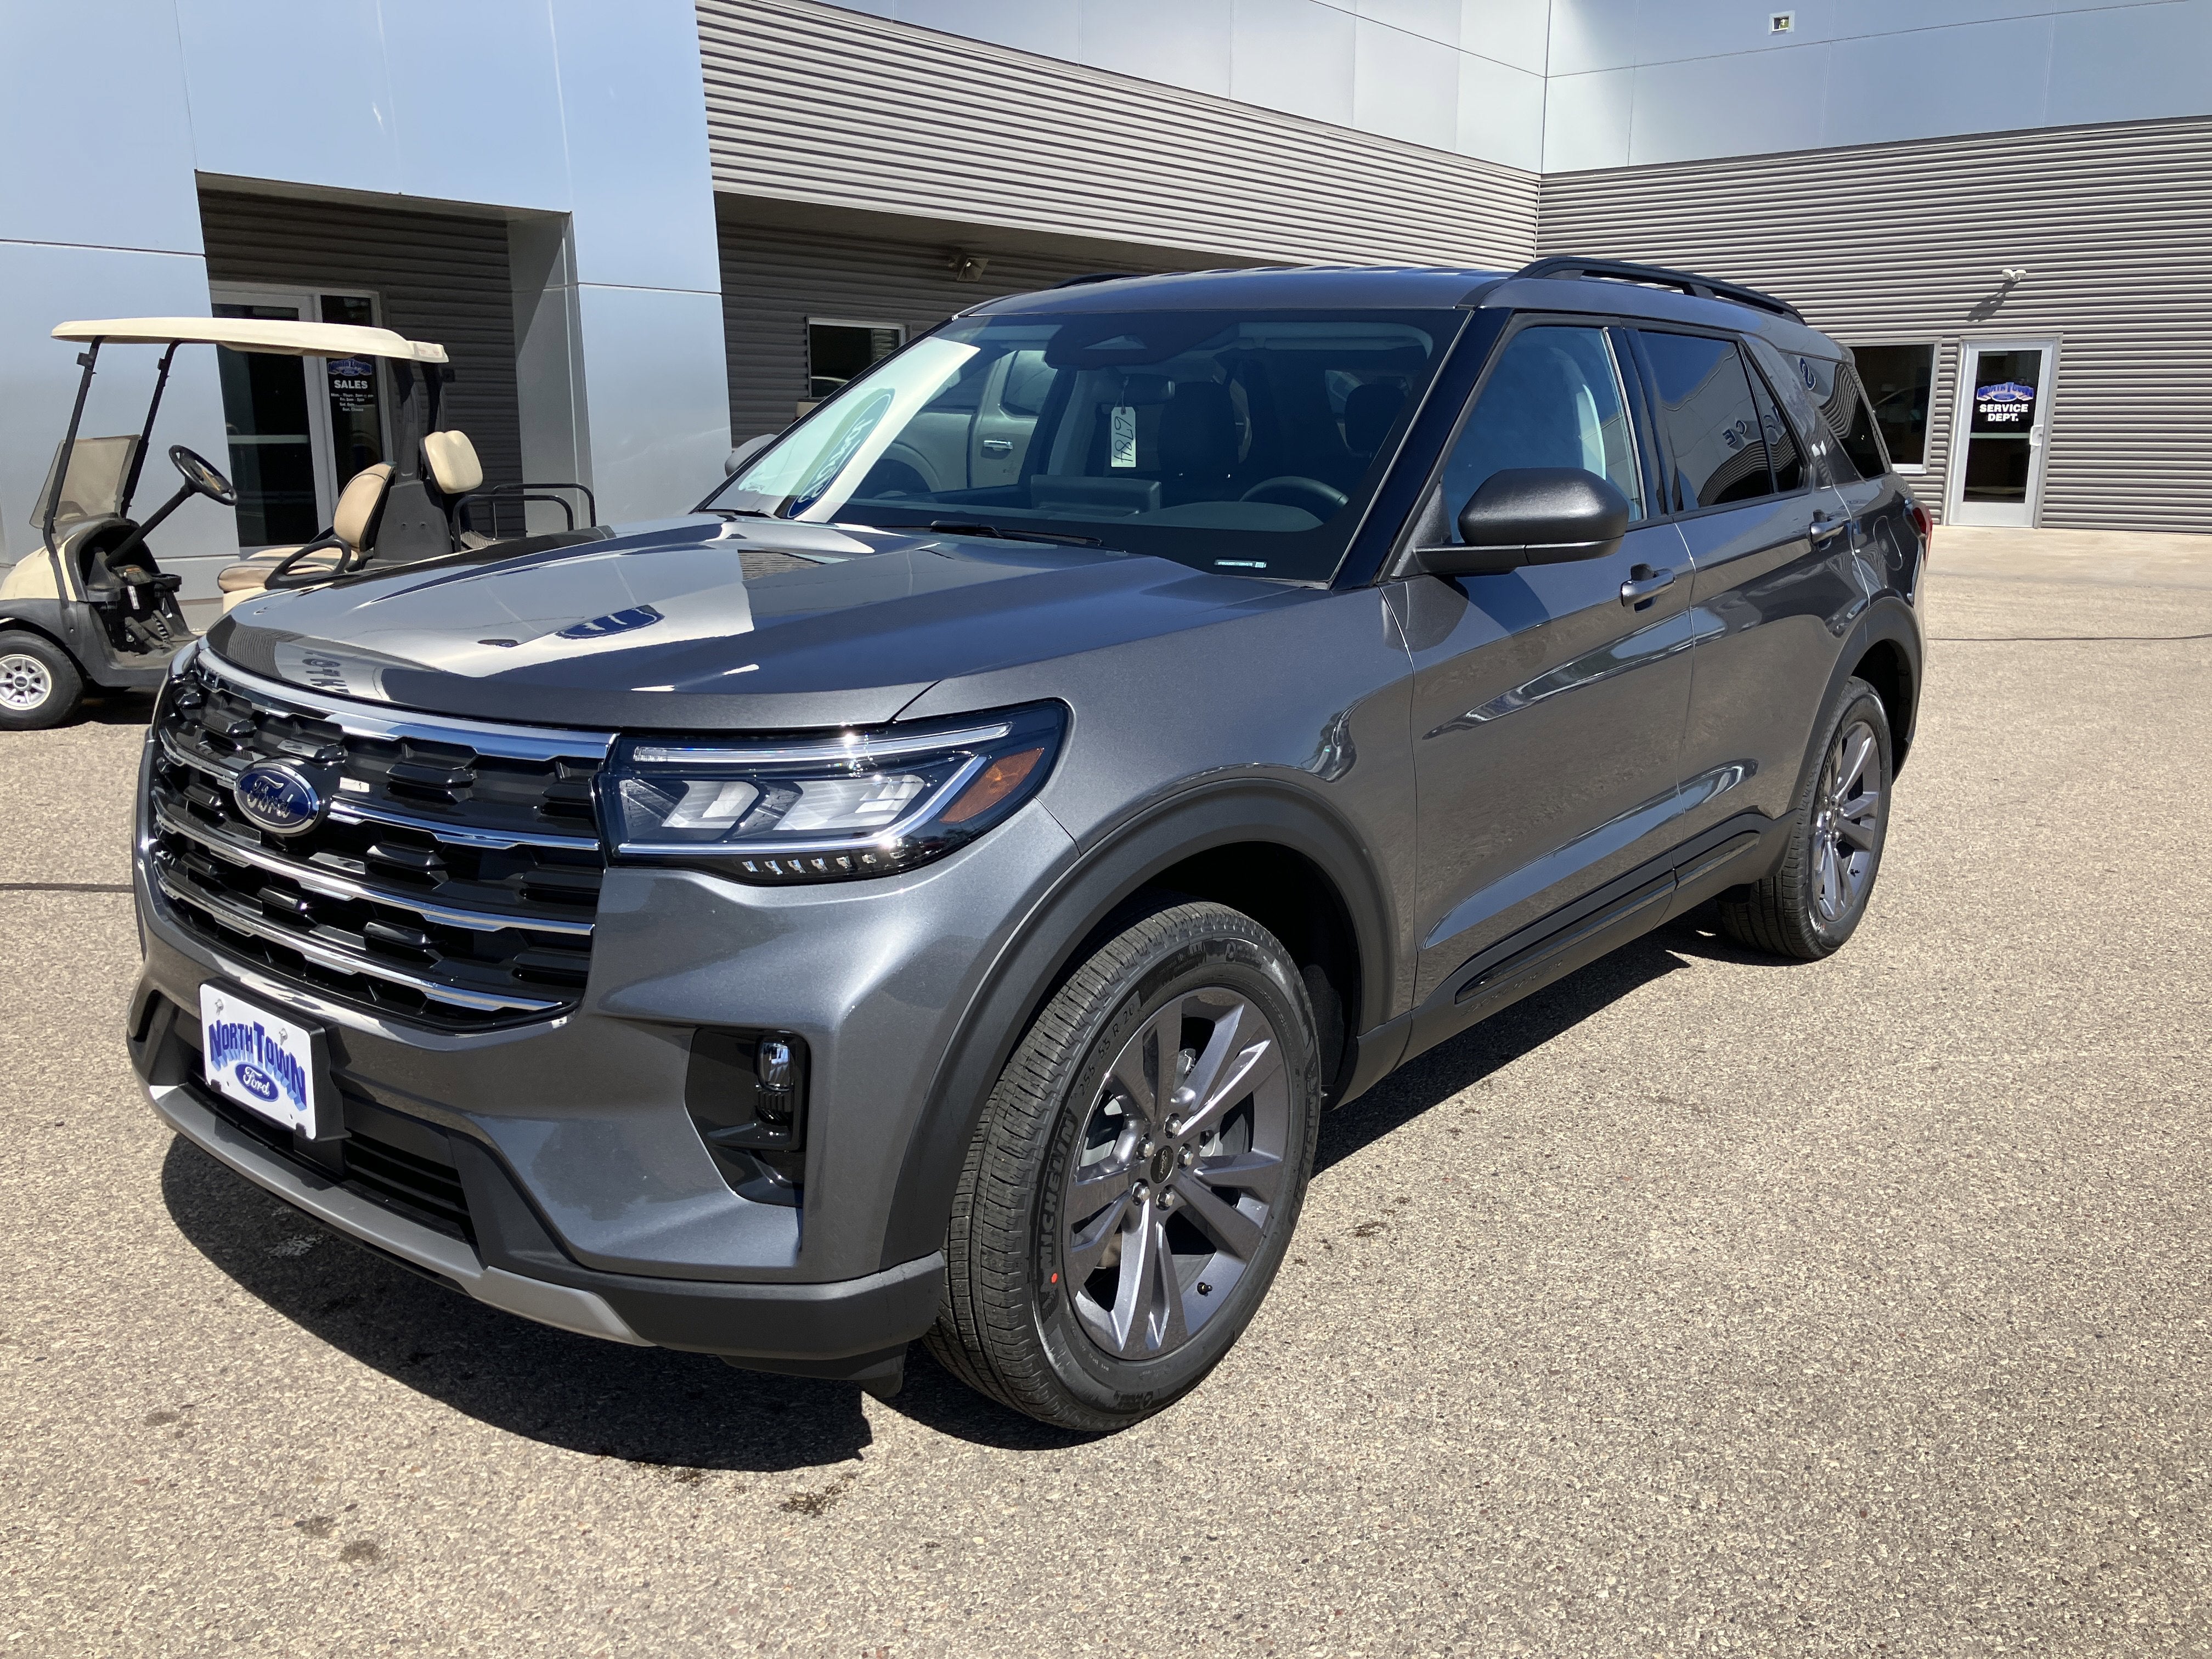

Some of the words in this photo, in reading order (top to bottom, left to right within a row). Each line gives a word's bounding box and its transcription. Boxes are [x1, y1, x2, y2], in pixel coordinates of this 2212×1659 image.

[334, 380, 368, 390] SALES
[1979, 404, 2029, 413] SERVICE
[1987, 413, 2019, 422] DEPT.
[1114, 416, 1134, 463] 6784
[247, 775, 294, 819] Ford
[242, 1066, 271, 1097] Ford
[1040, 1117, 1077, 1269] MICHELIN
